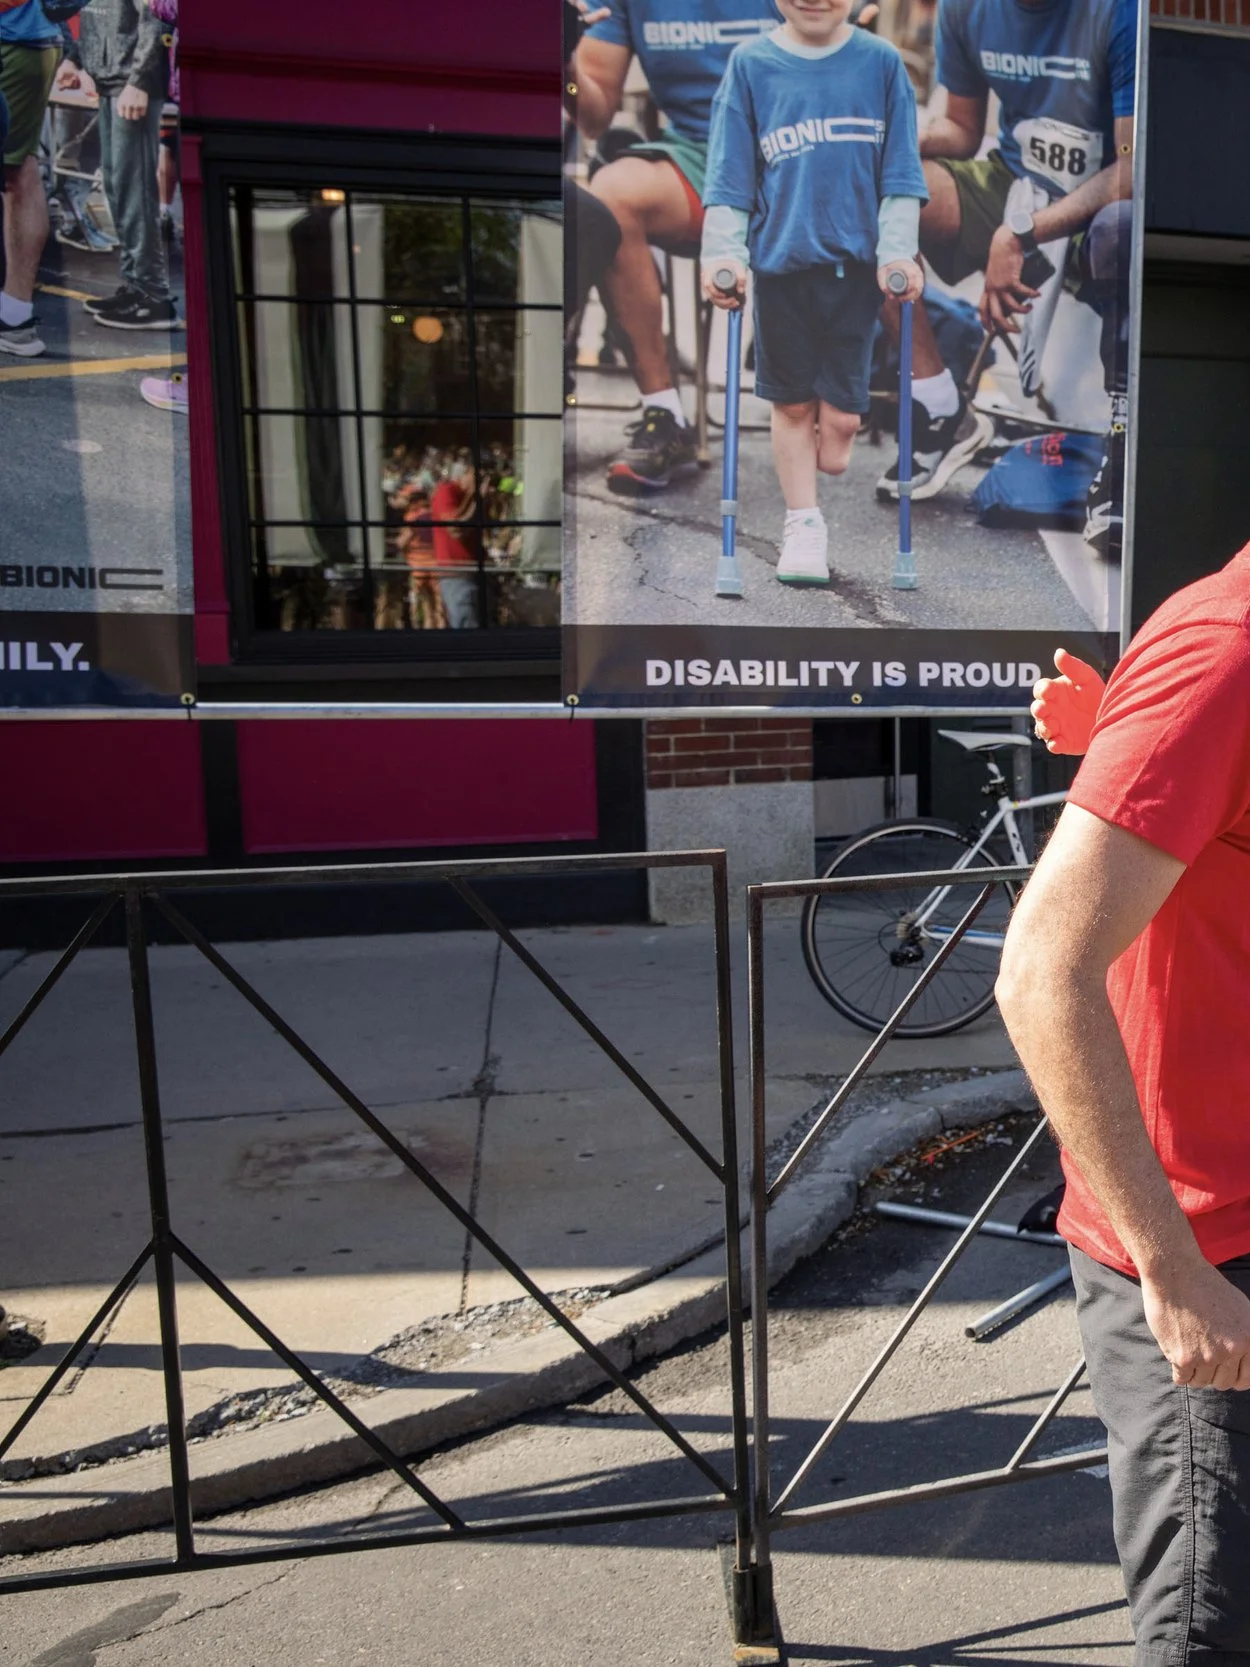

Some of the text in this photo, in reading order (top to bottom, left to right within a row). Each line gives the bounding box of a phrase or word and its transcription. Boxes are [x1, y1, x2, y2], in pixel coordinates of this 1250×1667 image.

[643, 20, 759, 44] BIONIC
[980, 51, 1075, 79] BIONIC
[760, 117, 875, 164] BIONIC
[1030, 135, 1086, 176] 588
[0, 565, 164, 590] BIONIC
[0, 641, 90, 671] ILY.
[646, 659, 1041, 687] DISABILITY IS PROUD
